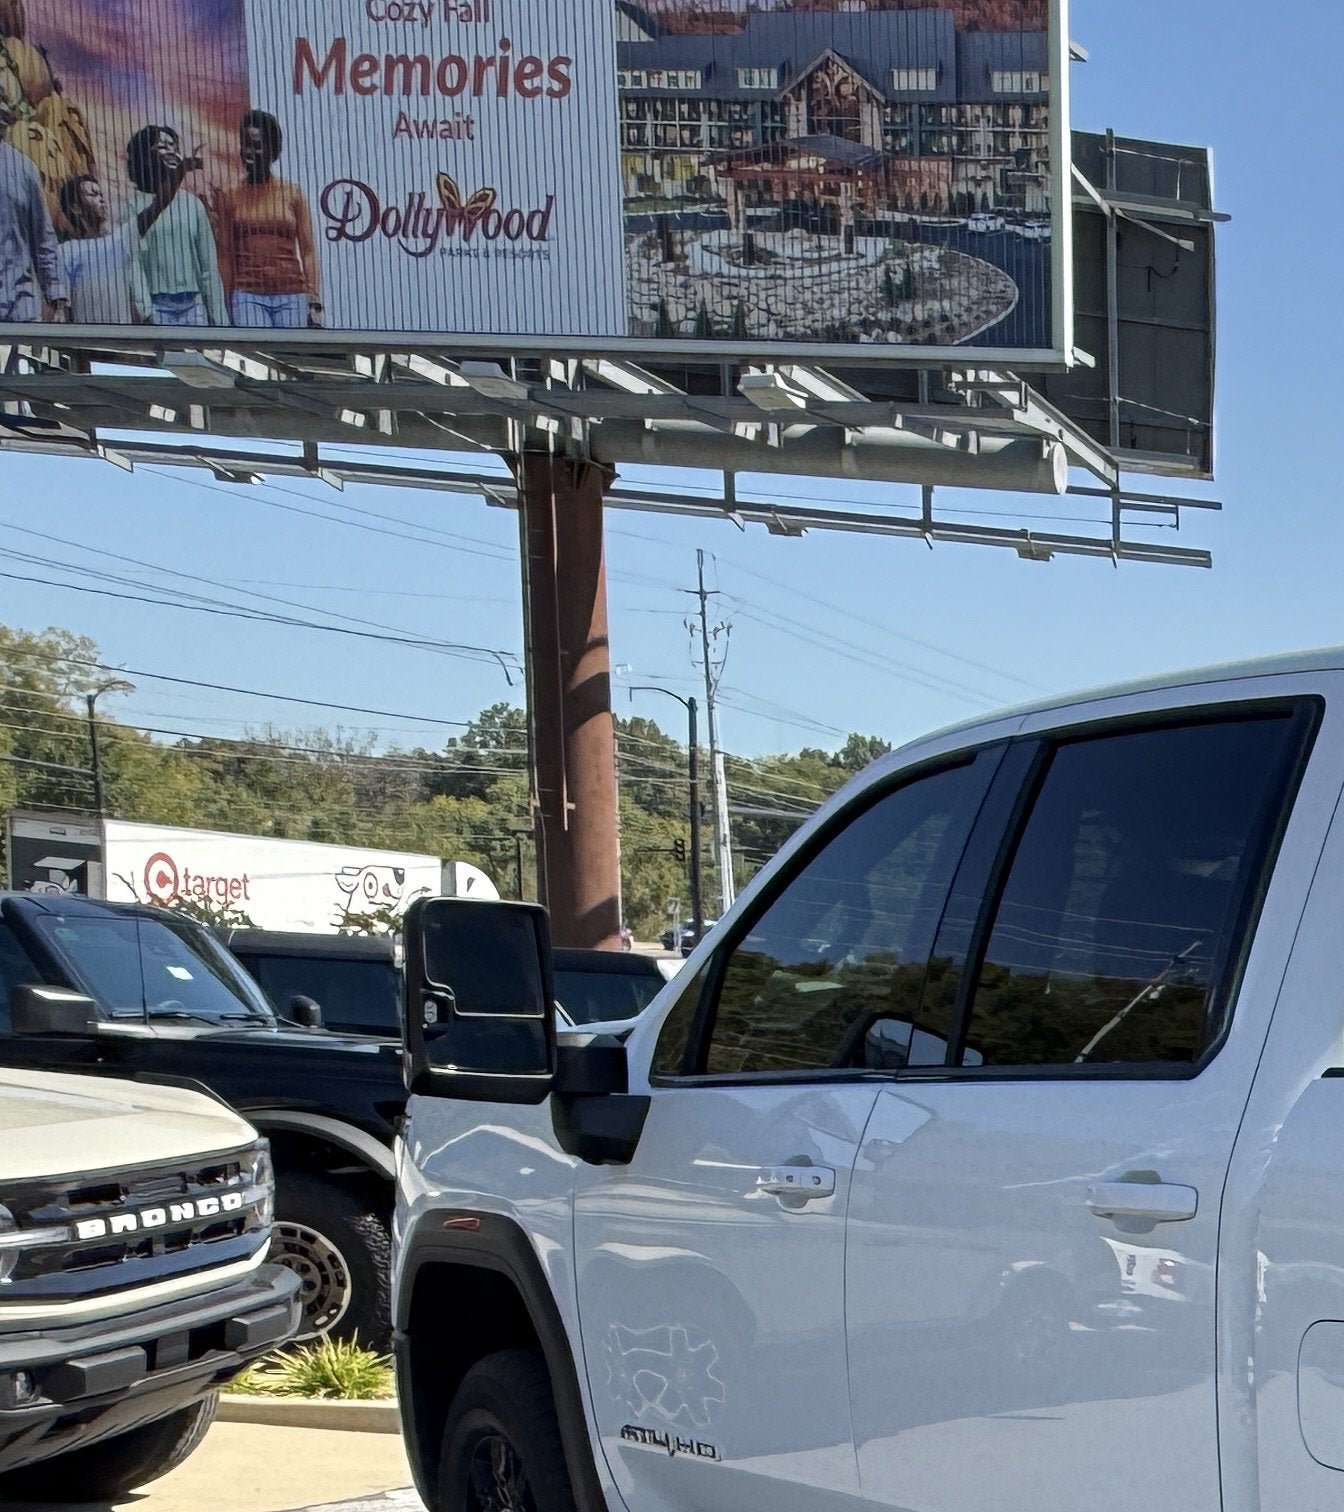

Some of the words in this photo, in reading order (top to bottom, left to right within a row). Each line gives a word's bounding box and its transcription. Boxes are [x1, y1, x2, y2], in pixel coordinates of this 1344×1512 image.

[366, 0, 433, 28] Cozy
[444, 0, 490, 23] Fall
[293, 37, 572, 99] Memories
[392, 111, 475, 140] Await
[320, 174, 554, 258] Dollywood
[181, 867, 250, 906] target
[76, 1192, 243, 1240] BRONCO
